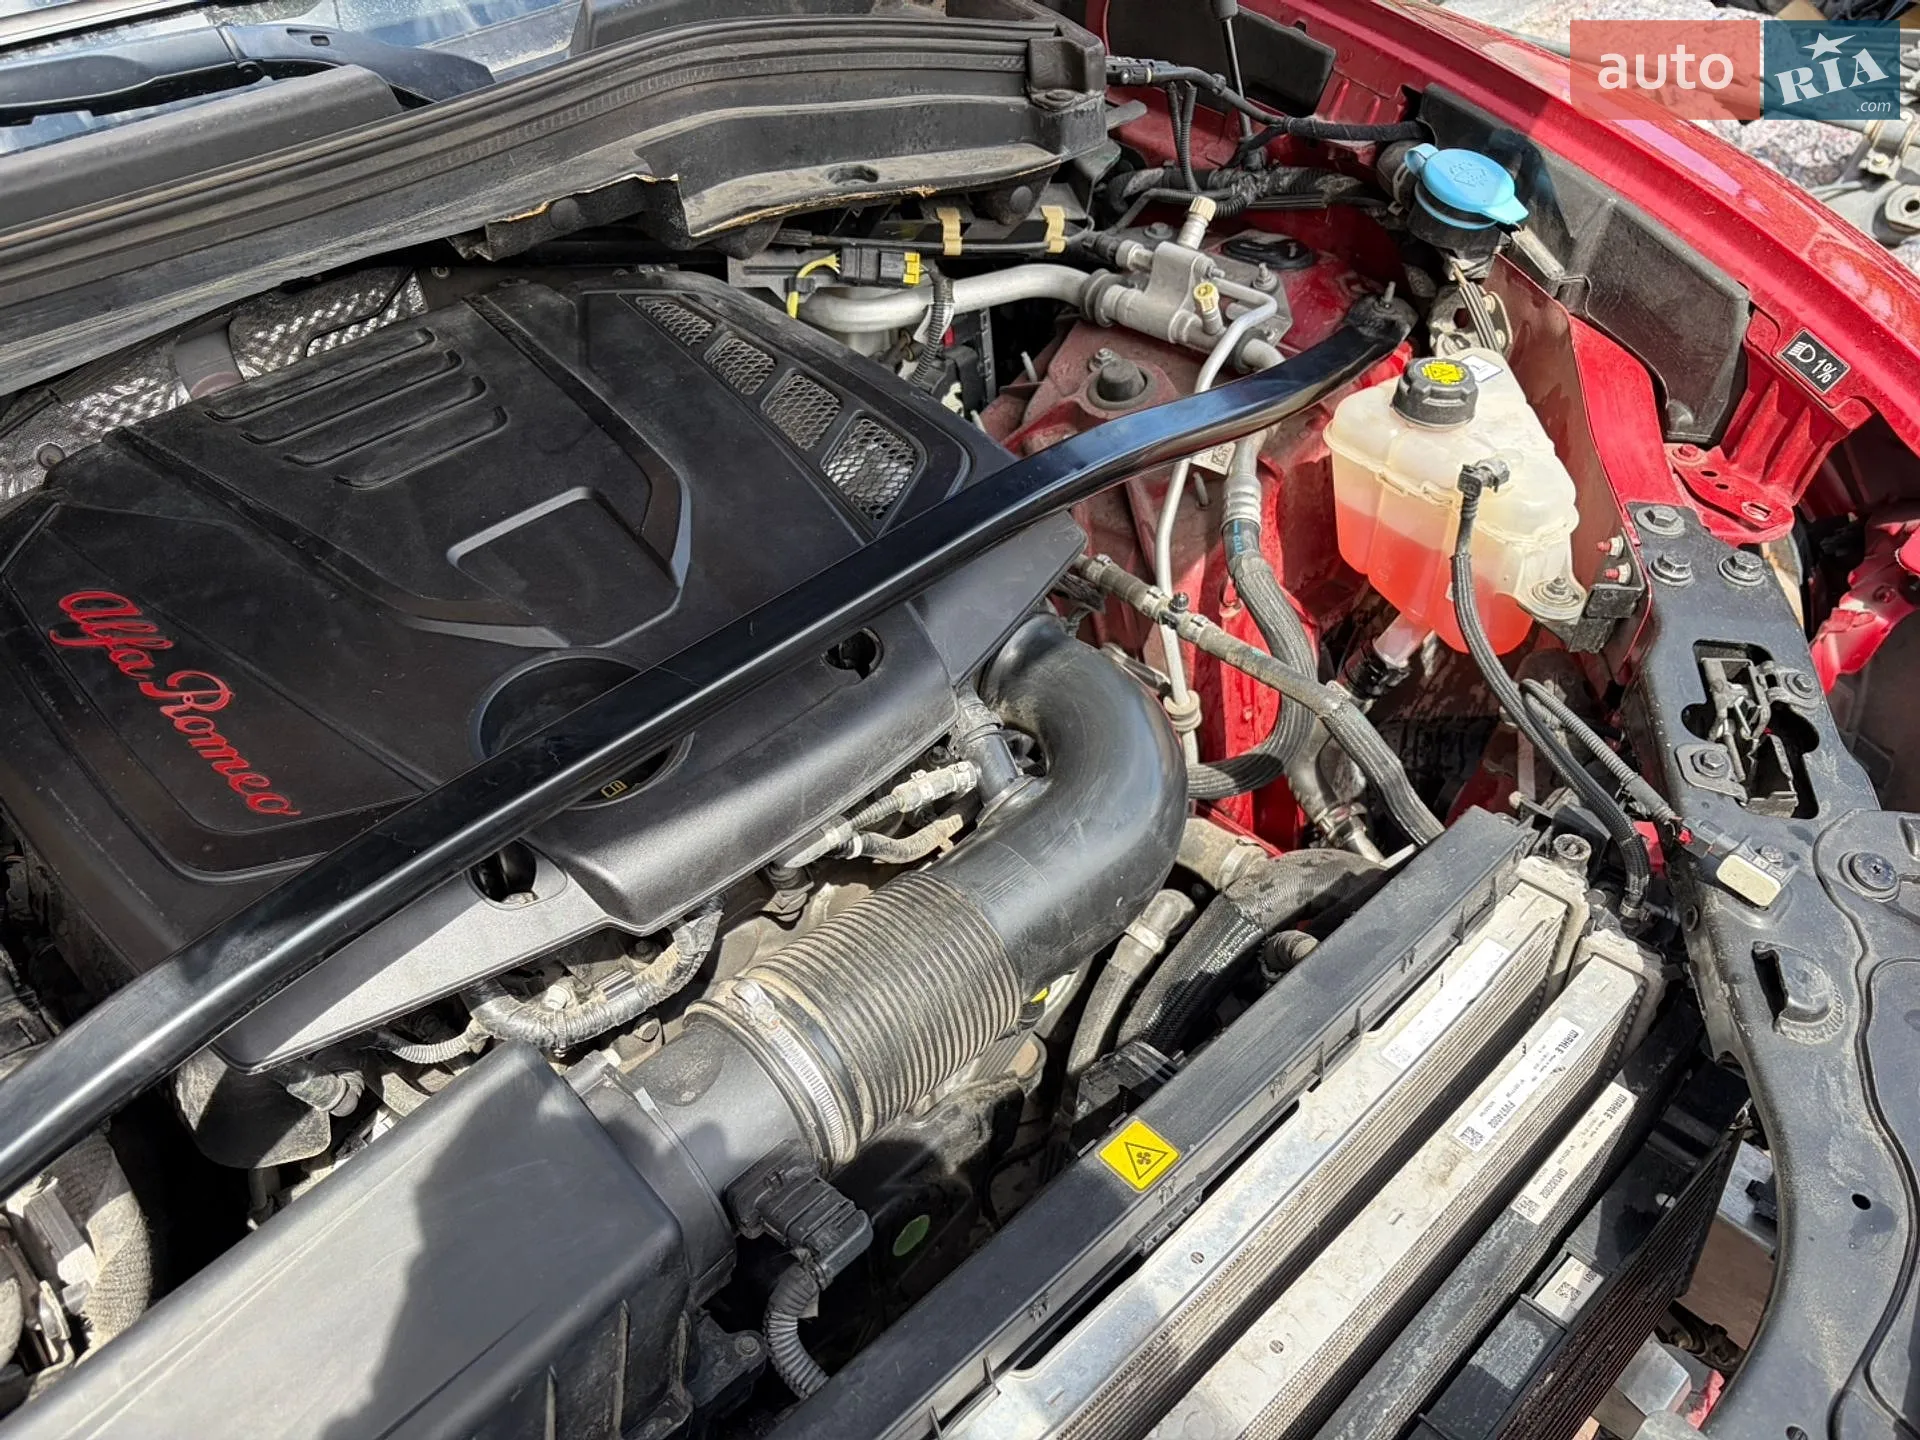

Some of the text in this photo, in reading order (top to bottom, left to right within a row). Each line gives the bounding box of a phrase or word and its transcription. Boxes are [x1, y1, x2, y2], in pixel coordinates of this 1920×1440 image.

[1811, 358, 1838, 384] 1%
[49, 590, 302, 815] Alfa Romeo
[1554, 1029, 1580, 1055] MAHLE
[1606, 1094, 1628, 1120] MAHLE
